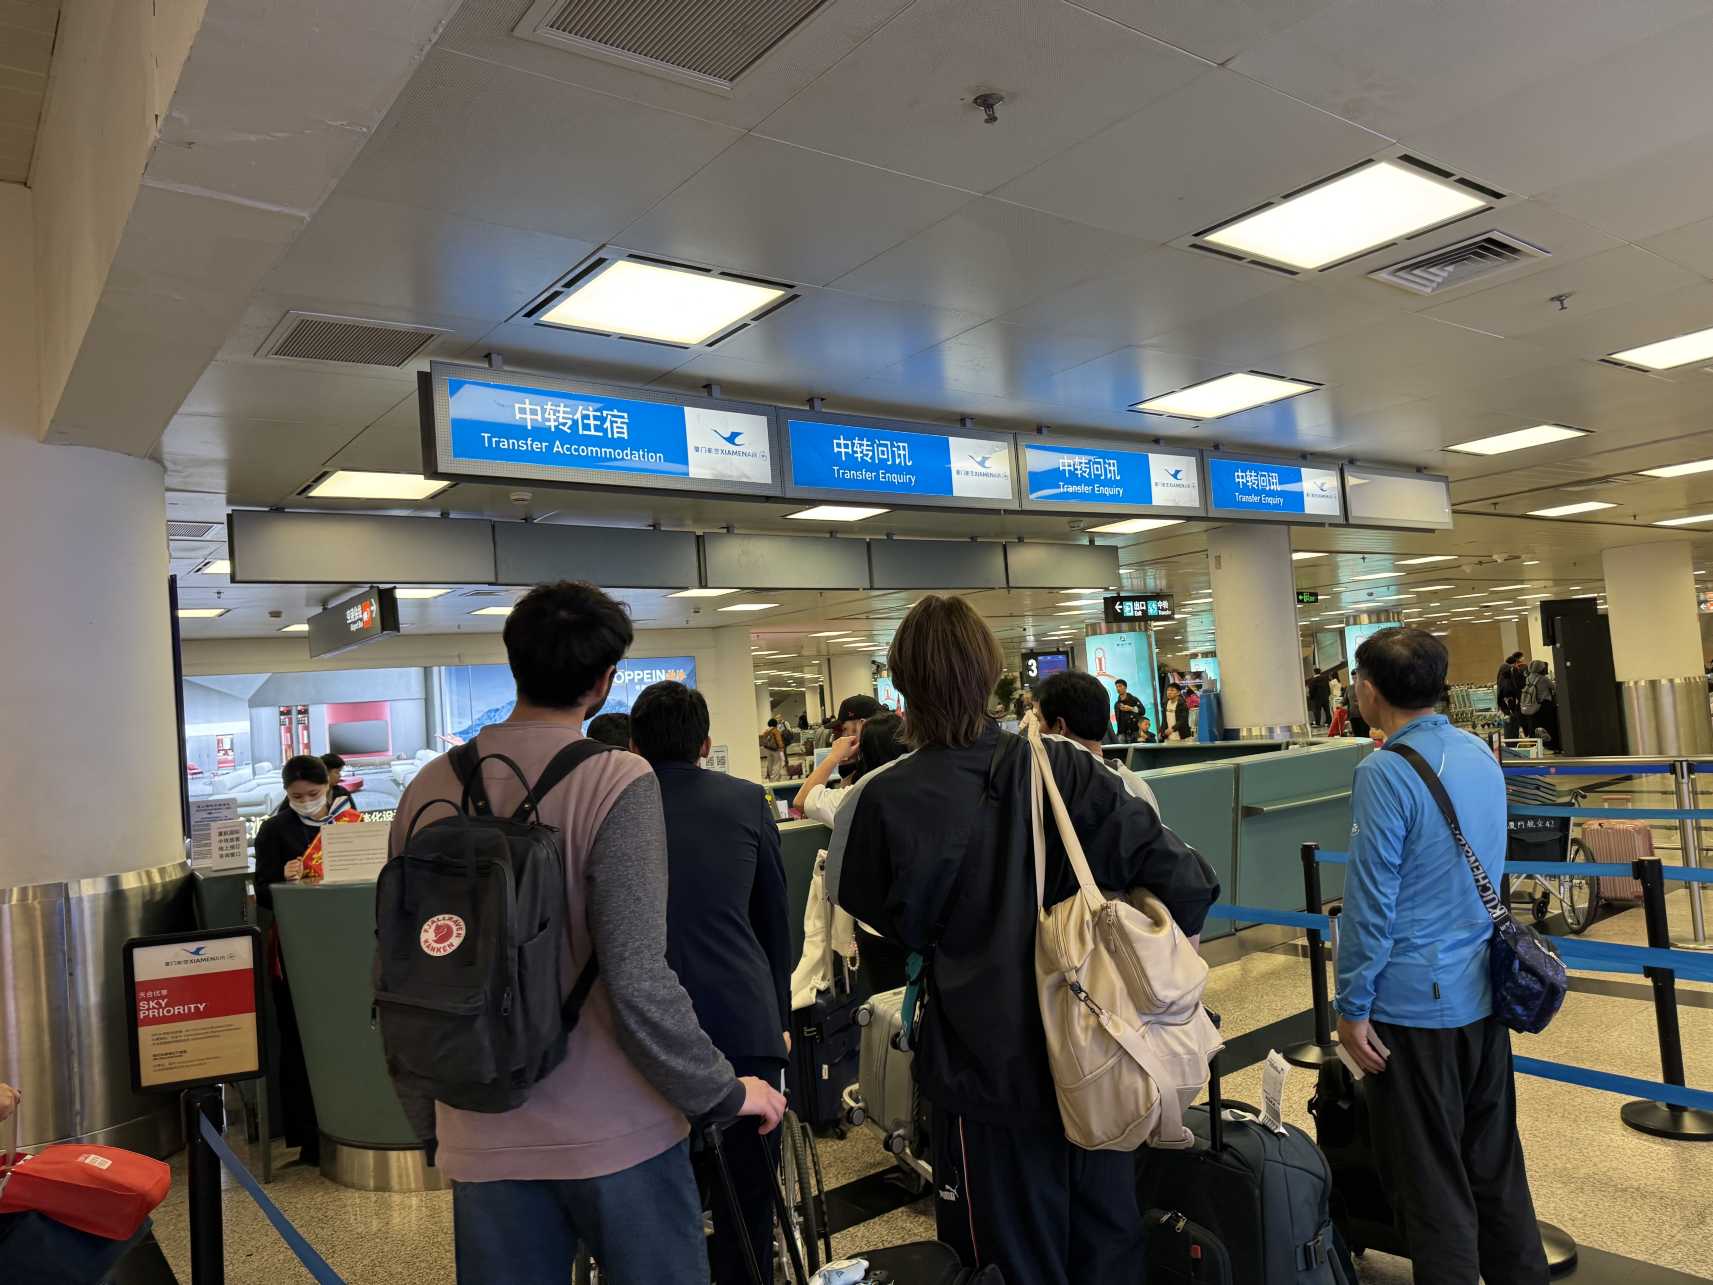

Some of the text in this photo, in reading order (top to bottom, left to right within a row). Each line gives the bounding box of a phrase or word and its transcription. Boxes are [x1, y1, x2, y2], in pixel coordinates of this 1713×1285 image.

[514, 399, 629, 440] 中转住宿
[481, 432, 665, 464] Transfer Accommodation
[832, 435, 913, 467] 中转问讯
[832, 466, 916, 486] Transfer Enquiry
[1059, 455, 1121, 481] 中转问讯
[1058, 481, 1124, 498] Transfer Enquiry
[1234, 469, 1281, 492] 中转问讯
[1235, 492, 1284, 507] Transfer Enquiry
[614, 669, 666, 684] OPPEIN
[1027, 659, 1037, 677] 3
[139, 999, 168, 1010] SKY
[140, 1003, 206, 1019] PRIORITY
